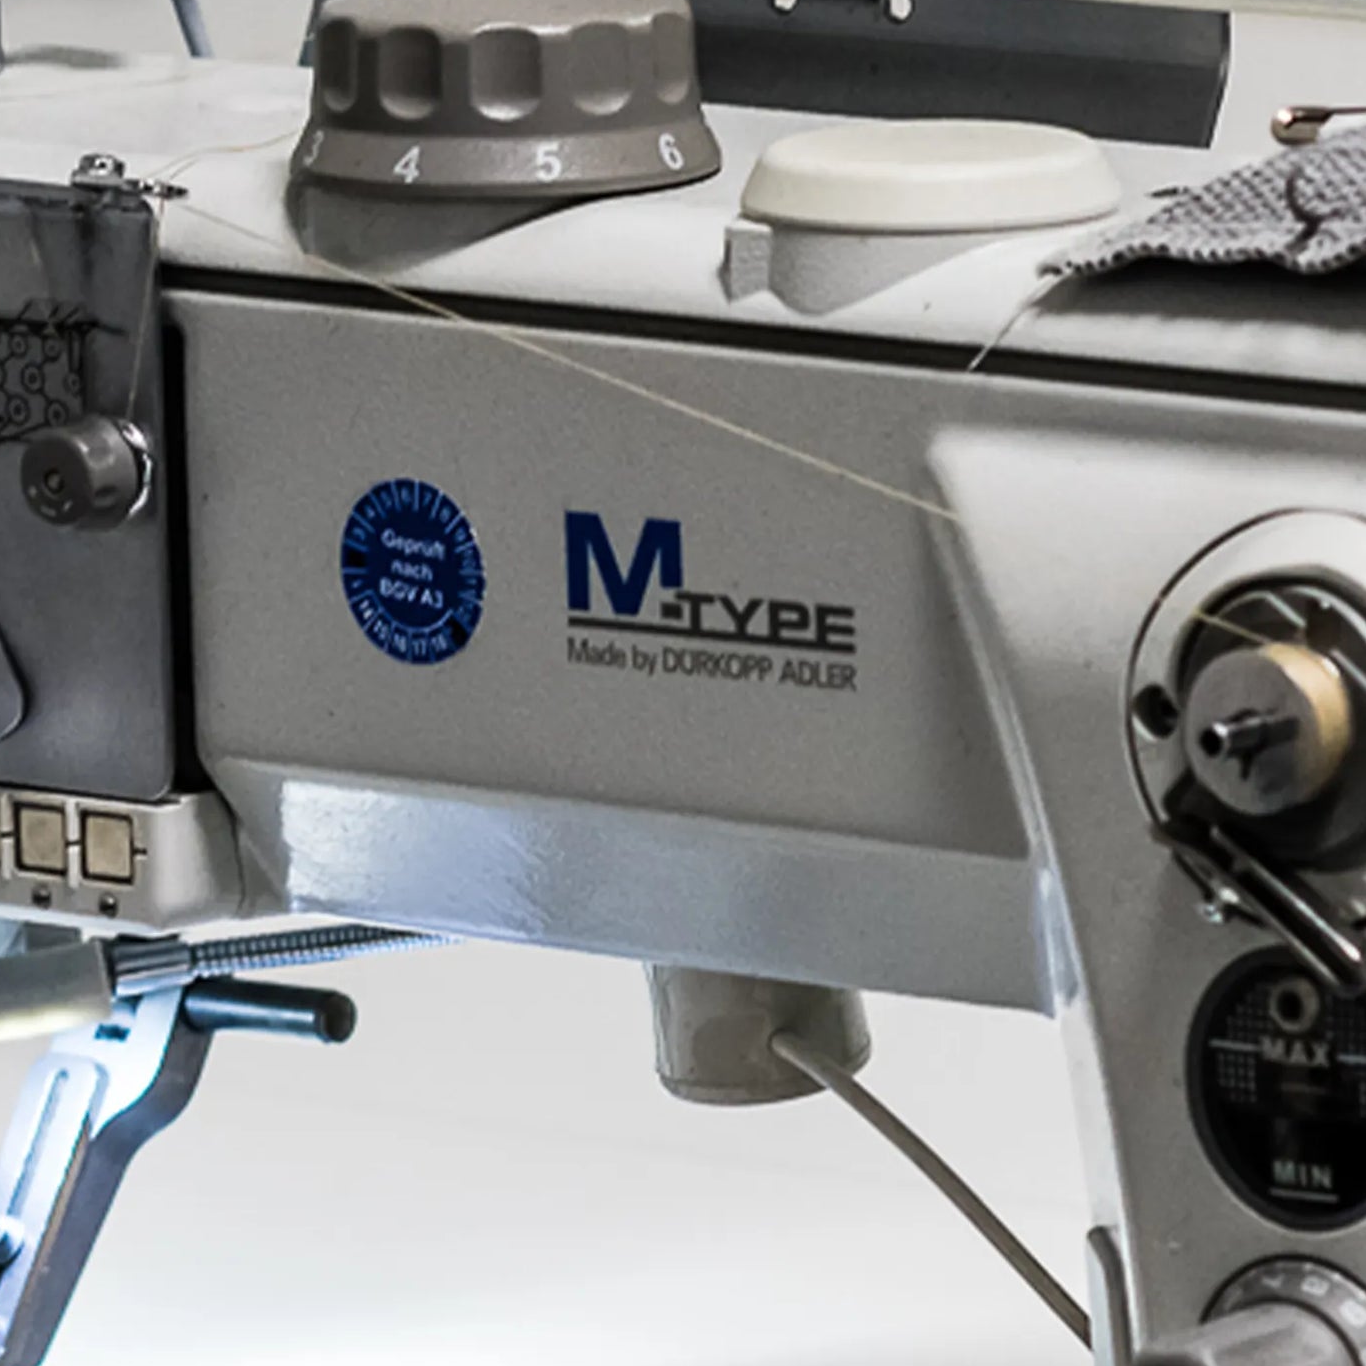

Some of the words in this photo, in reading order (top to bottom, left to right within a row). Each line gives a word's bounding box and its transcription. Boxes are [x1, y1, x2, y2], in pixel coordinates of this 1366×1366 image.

[394, 145, 421, 184] 4
[535, 141, 563, 181] 5
[658, 133, 686, 170] 6
[391, 559, 433, 582] nach
[567, 637, 627, 669] Made
[632, 645, 658, 676] by
[779, 659, 858, 691] ADLER
[1260, 1036, 1328, 1066] MAX
[1273, 1160, 1331, 1188] MIN
